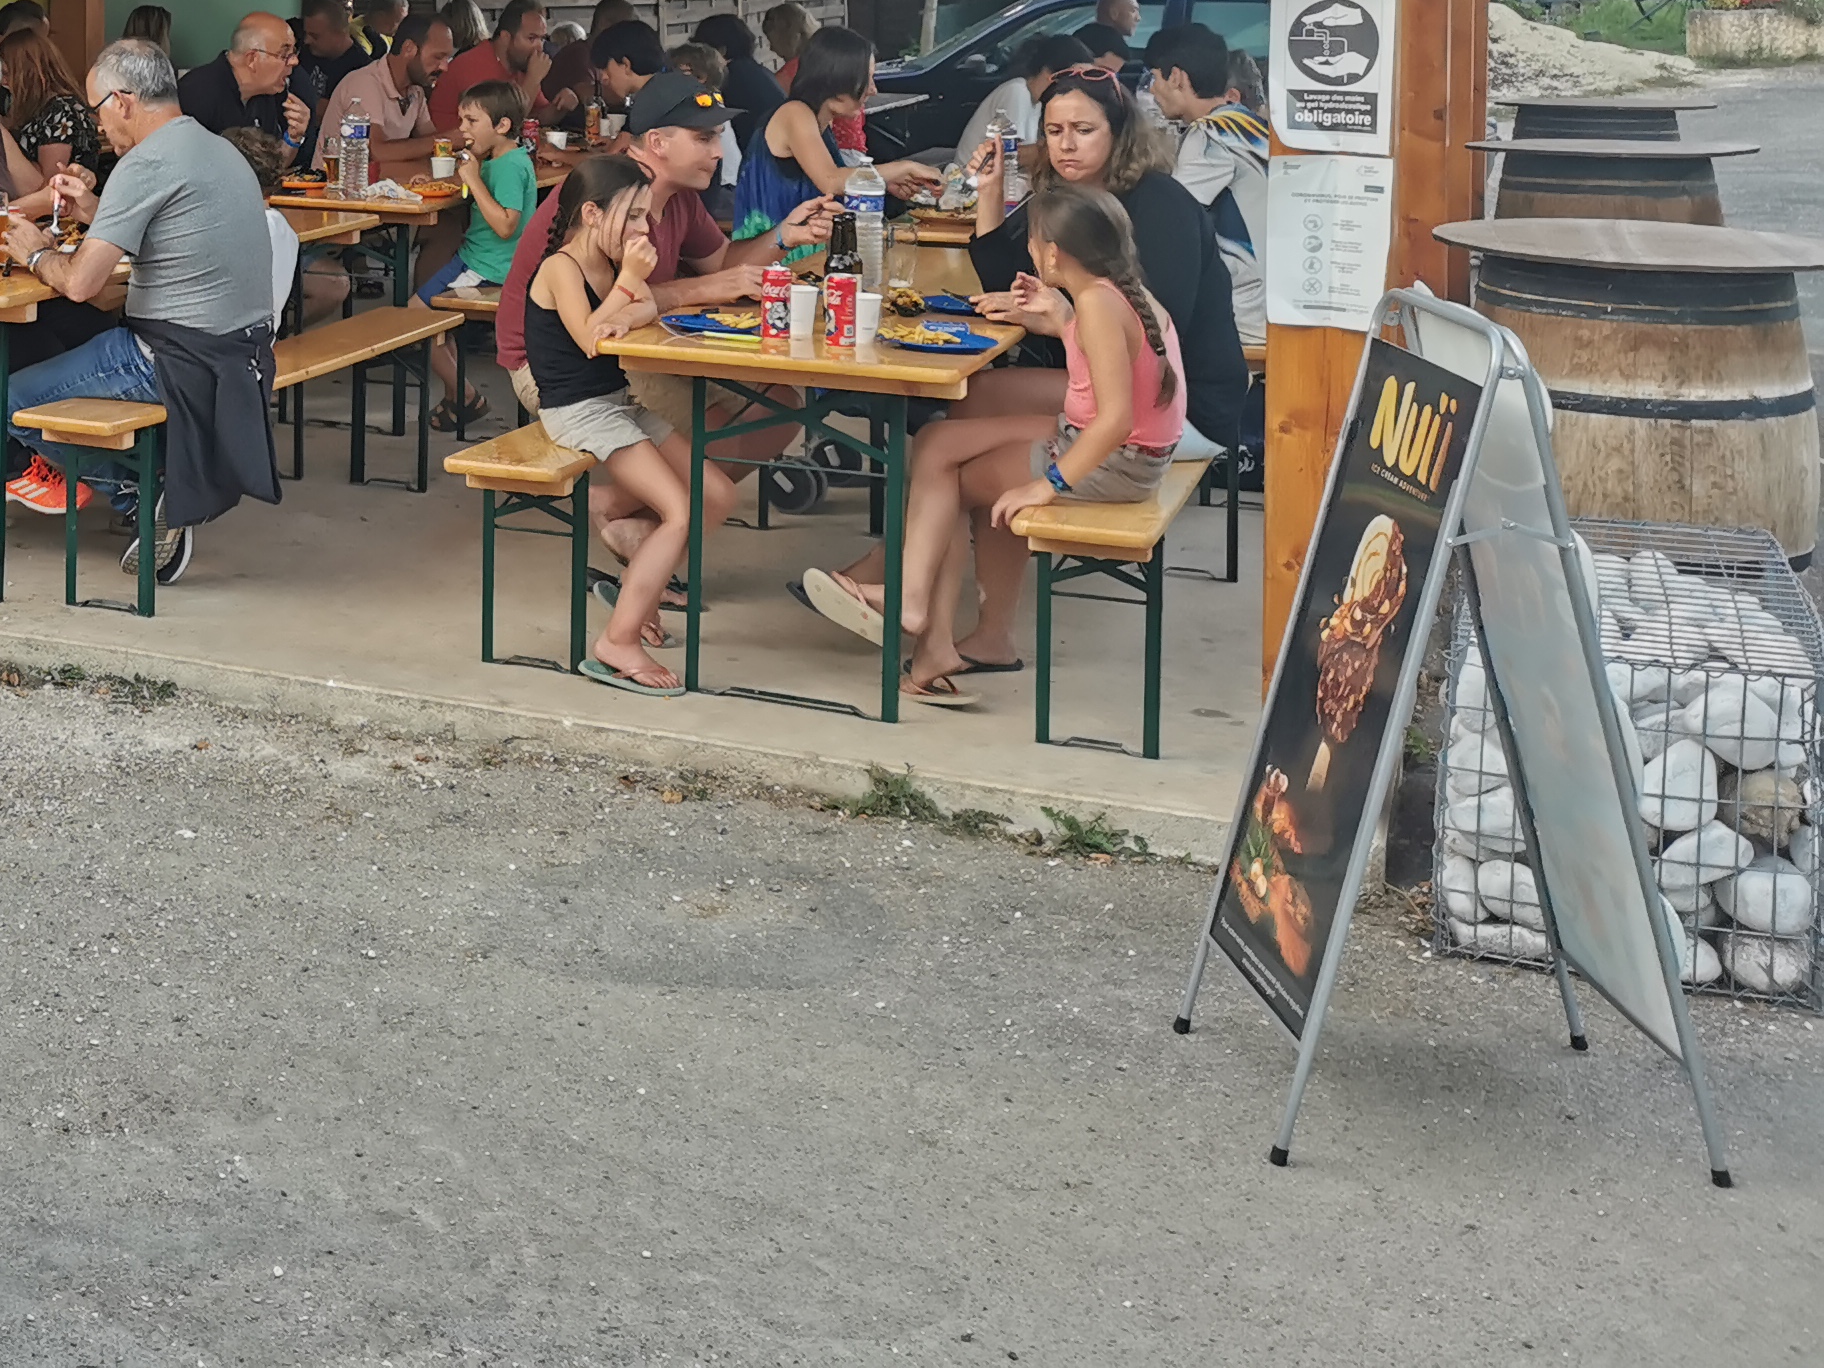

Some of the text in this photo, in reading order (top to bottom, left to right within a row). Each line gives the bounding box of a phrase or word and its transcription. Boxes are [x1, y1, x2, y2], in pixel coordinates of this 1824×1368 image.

[1304, 93, 1331, 102] Lavage
[1332, 94, 1344, 102] des
[1307, 101, 1319, 109] gel
[1295, 110, 1372, 126] obligatoire
[1370, 462, 1380, 475] ICE
[1380, 468, 1398, 485] CREAM
